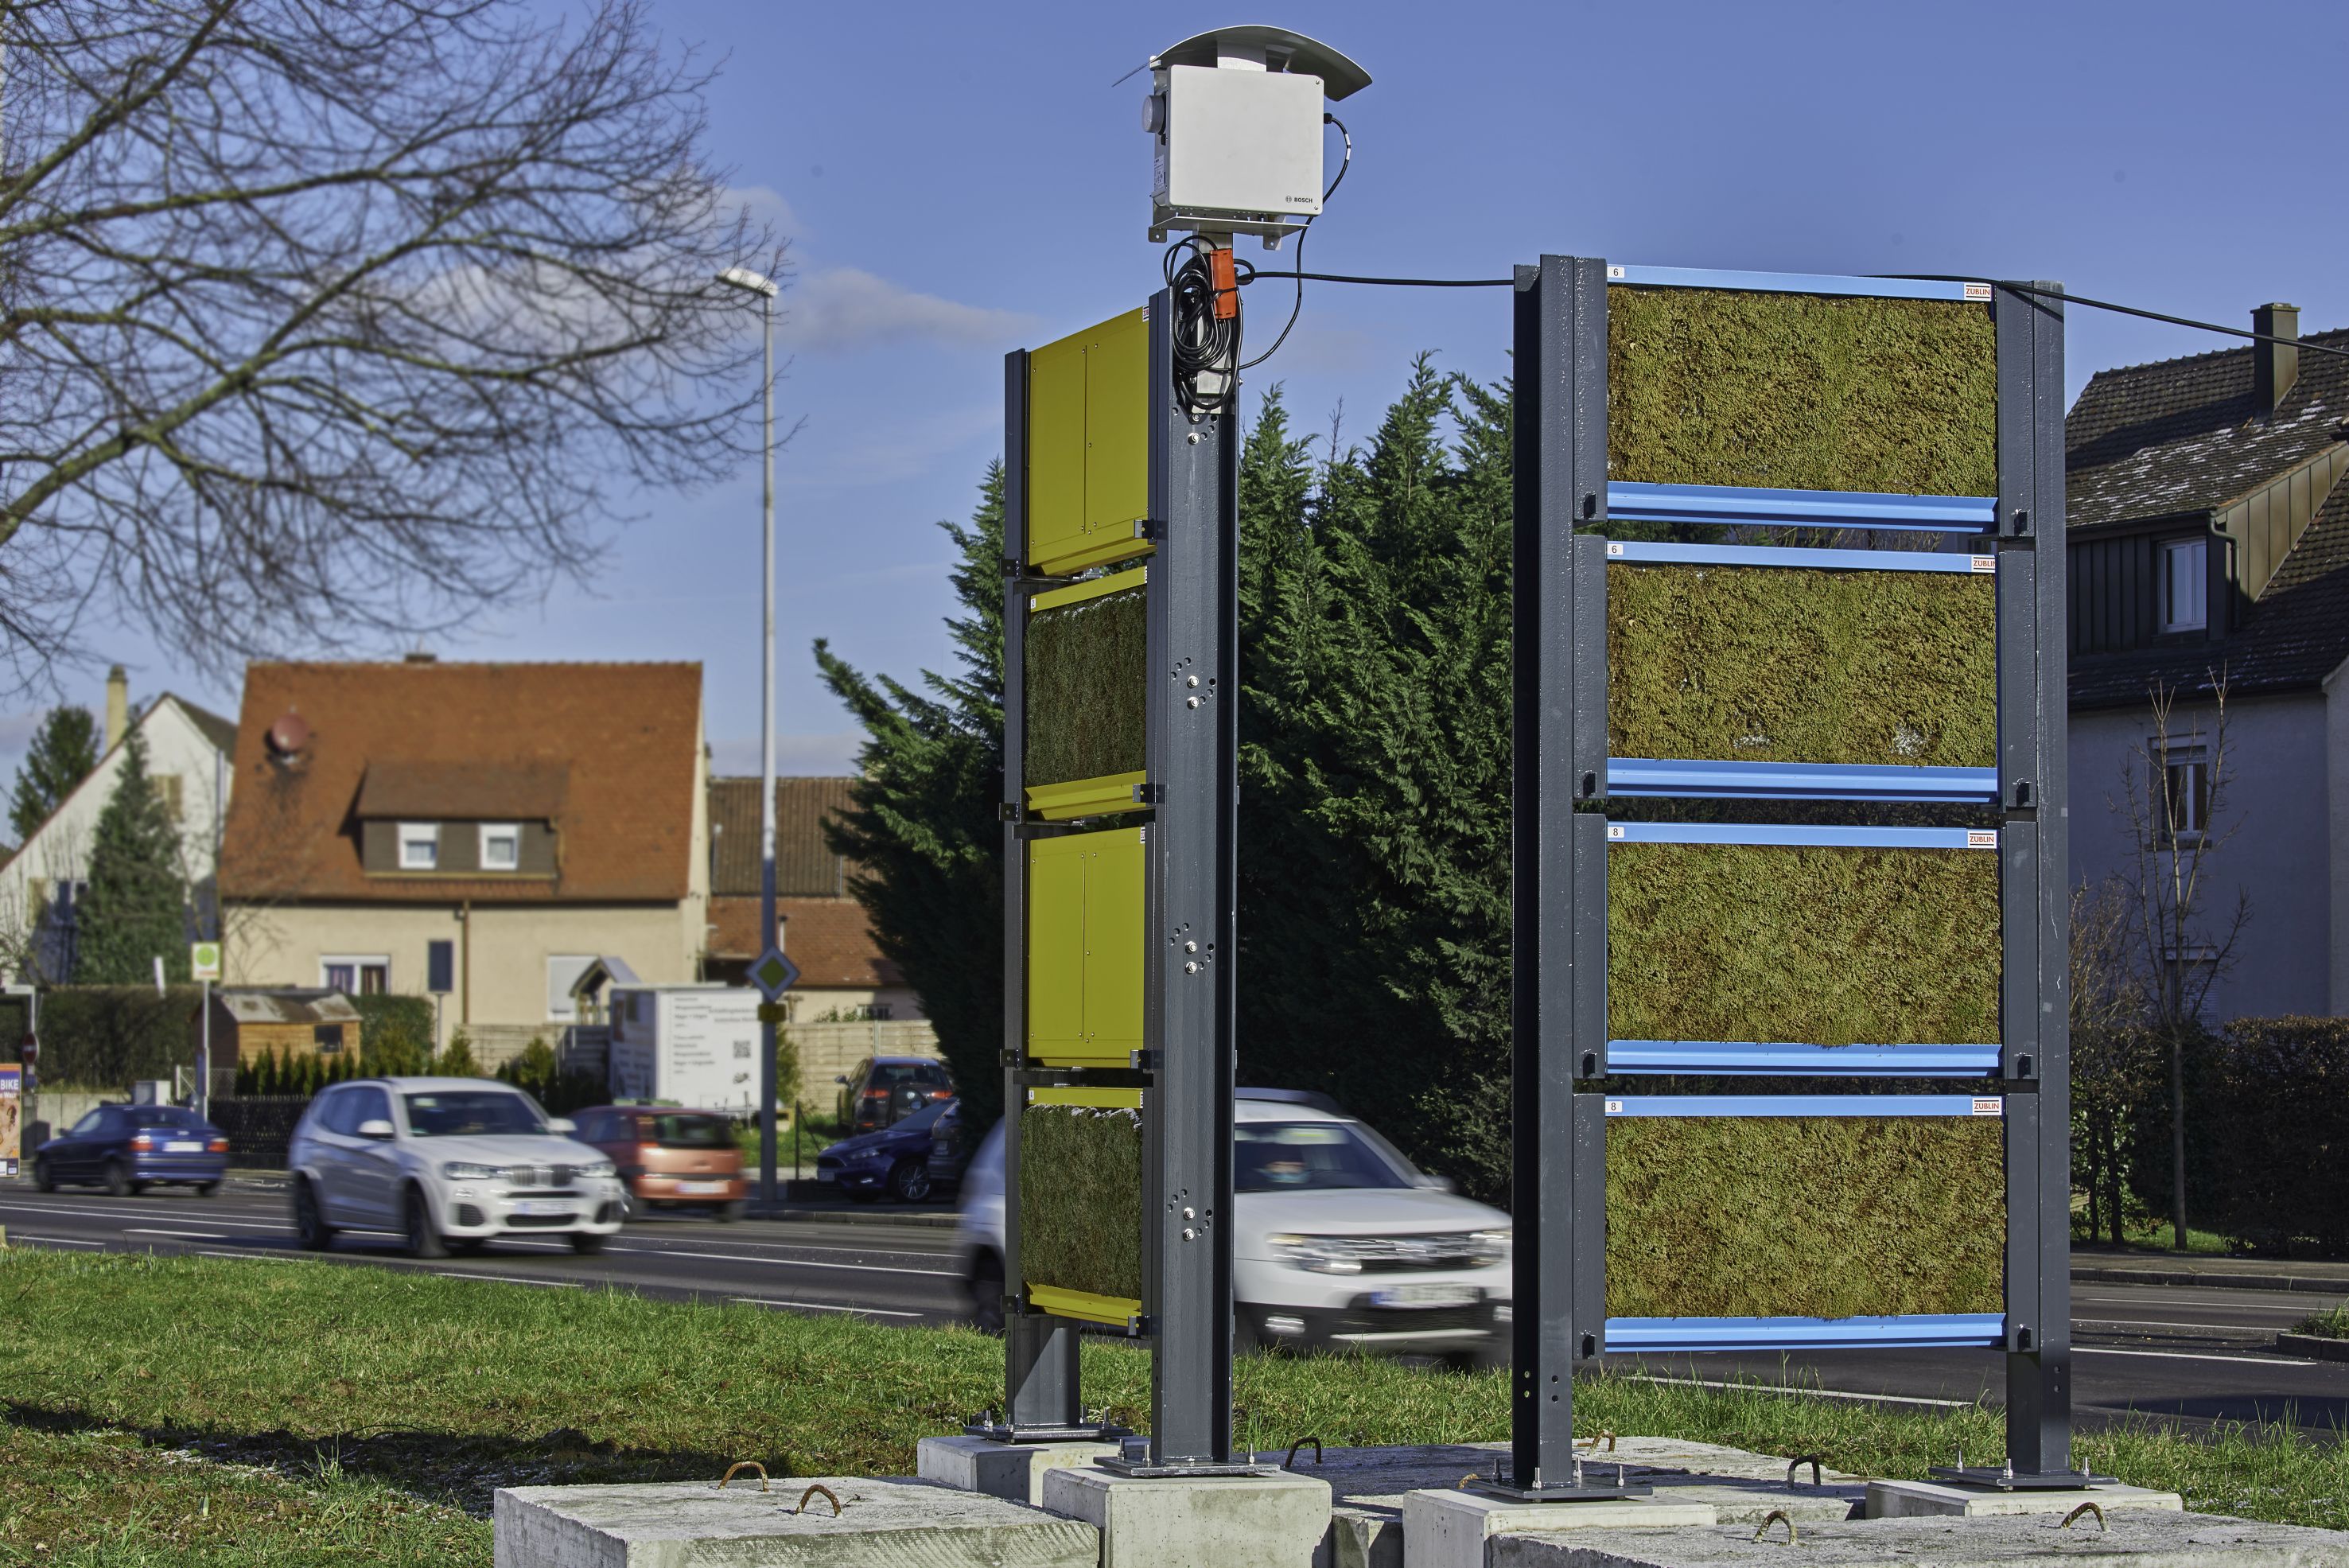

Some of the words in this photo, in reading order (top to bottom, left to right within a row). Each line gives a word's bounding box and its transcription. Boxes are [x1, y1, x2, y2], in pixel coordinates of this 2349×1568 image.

[1612, 545, 1617, 554] 6
[1613, 827, 1619, 836] 8
[0, 1079, 19, 1090] BIKE
[1611, 1102, 1616, 1111] 8
